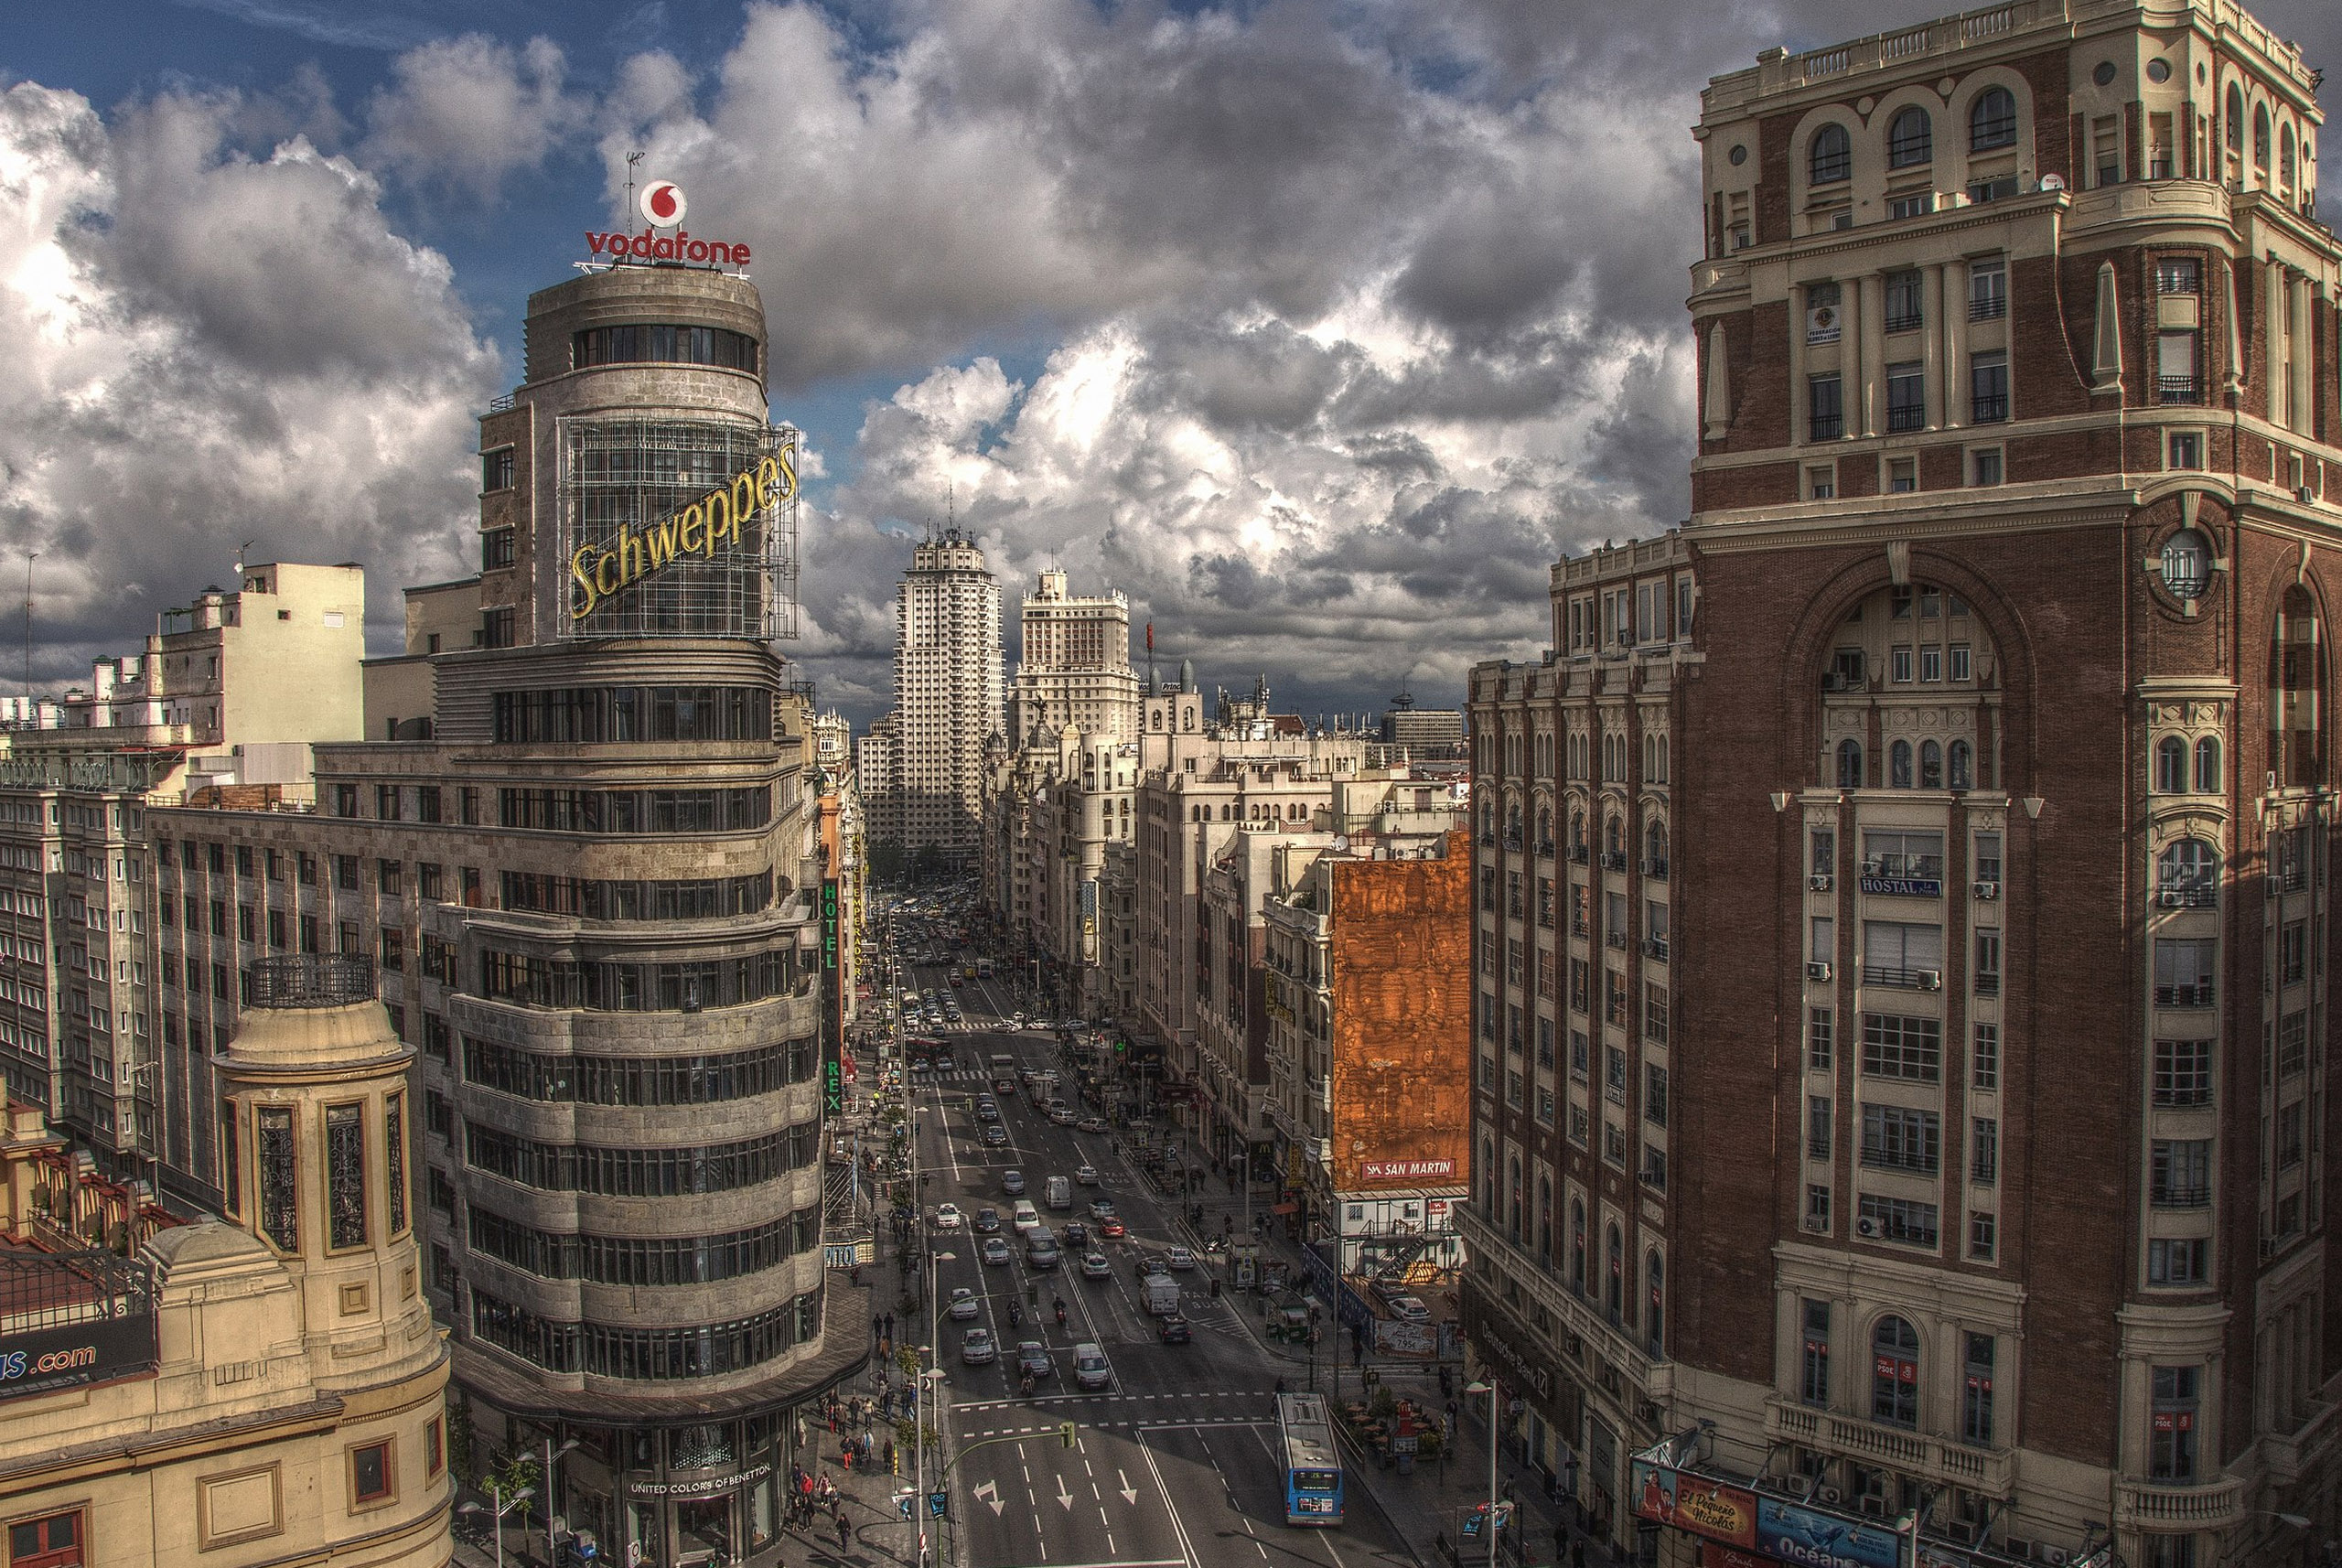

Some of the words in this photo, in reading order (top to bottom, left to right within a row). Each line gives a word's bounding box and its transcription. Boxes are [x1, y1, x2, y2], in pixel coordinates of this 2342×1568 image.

[585, 229, 751, 265] vodafone
[572, 442, 798, 620] Schweppes
[1861, 879, 1918, 895] HOSTAL
[824, 885, 837, 970] HOTEL
[852, 889, 862, 976] EMPERADOR
[827, 1061, 841, 1111] REX
[1384, 1164, 1407, 1176] SAN
[1410, 1161, 1451, 1175] MARTIN
[1191, 1301, 1222, 1309] BUS
[1482, 1320, 1517, 1367] Deutsche
[1517, 1355, 1538, 1389] Bank
[1877, 1364, 1895, 1375] PSOE
[631, 1482, 667, 1494] UNITED
[670, 1481, 712, 1493] COLORS
[714, 1477, 728, 1488] OF
[729, 1463, 772, 1486] BENETTON
[1680, 1488, 1694, 1505] El
[1696, 1493, 1736, 1517] Pequeño
[1692, 1506, 1735, 1531] Nicolás
